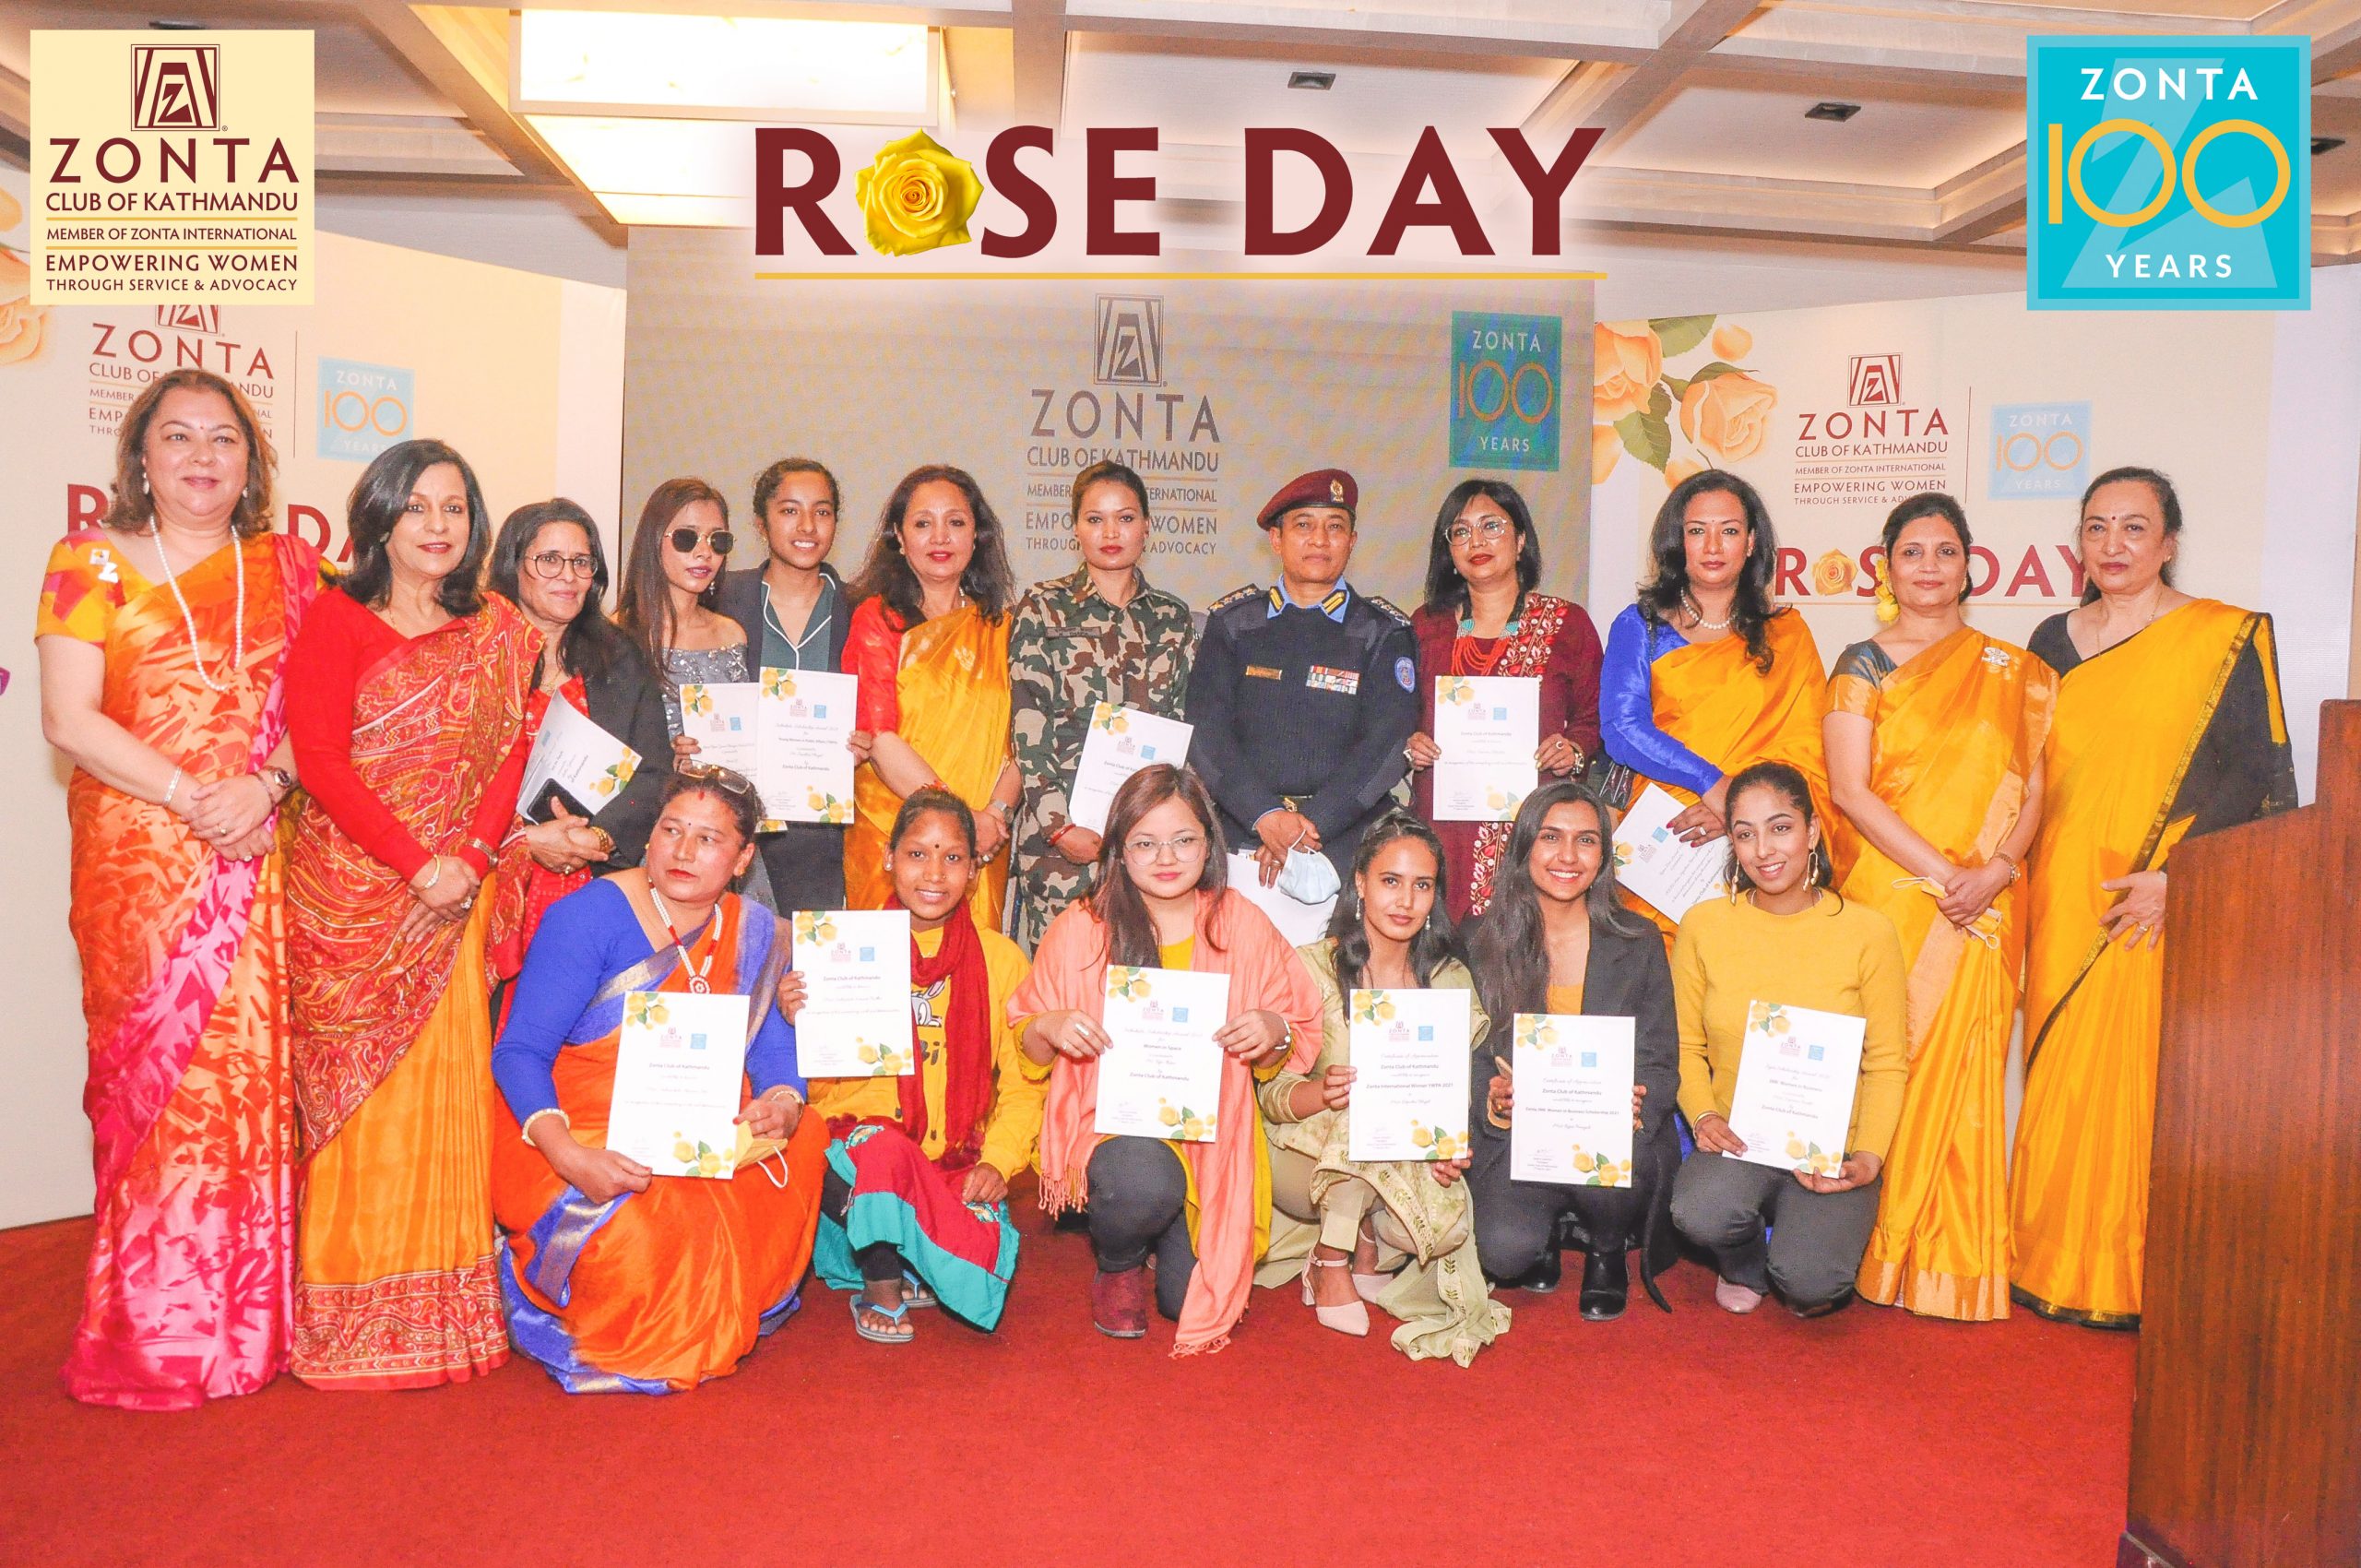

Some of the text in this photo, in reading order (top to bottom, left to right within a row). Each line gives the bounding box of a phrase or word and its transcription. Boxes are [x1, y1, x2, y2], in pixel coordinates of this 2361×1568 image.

[1473, 330, 1541, 352] ZONTA
[92, 323, 274, 379] ZONTA
[89, 362, 132, 380] CLUB
[337, 370, 397, 390] ZONTA
[89, 388, 134, 401] MEMBER
[1458, 359, 1553, 425] 100
[324, 389, 408, 437] 100
[1031, 389, 1220, 443] ZONTA
[2009, 413, 2072, 427] ZONTA
[1798, 408, 1949, 441] ZONTA
[1480, 436, 1530, 452] YEARS
[1796, 441, 1948, 457] CLUB OF KATHMANDU
[1996, 431, 2083, 472] 100
[1027, 446, 1218, 472] CLUB OF KATHMANDU
[1795, 463, 1946, 475] MEMBER OF ZONTA INTERNATIONAL
[1027, 483, 1072, 497] MEMBER
[1795, 480, 1946, 493] EMPOWERING WOMEN
[2015, 479, 2061, 490] YEARS
[1795, 496, 1840, 505] THROUGH
[1843, 495, 1880, 505] SERVICE
[1150, 516, 1216, 534] WOMEN
[1150, 541, 1216, 554] ADVOCACY
